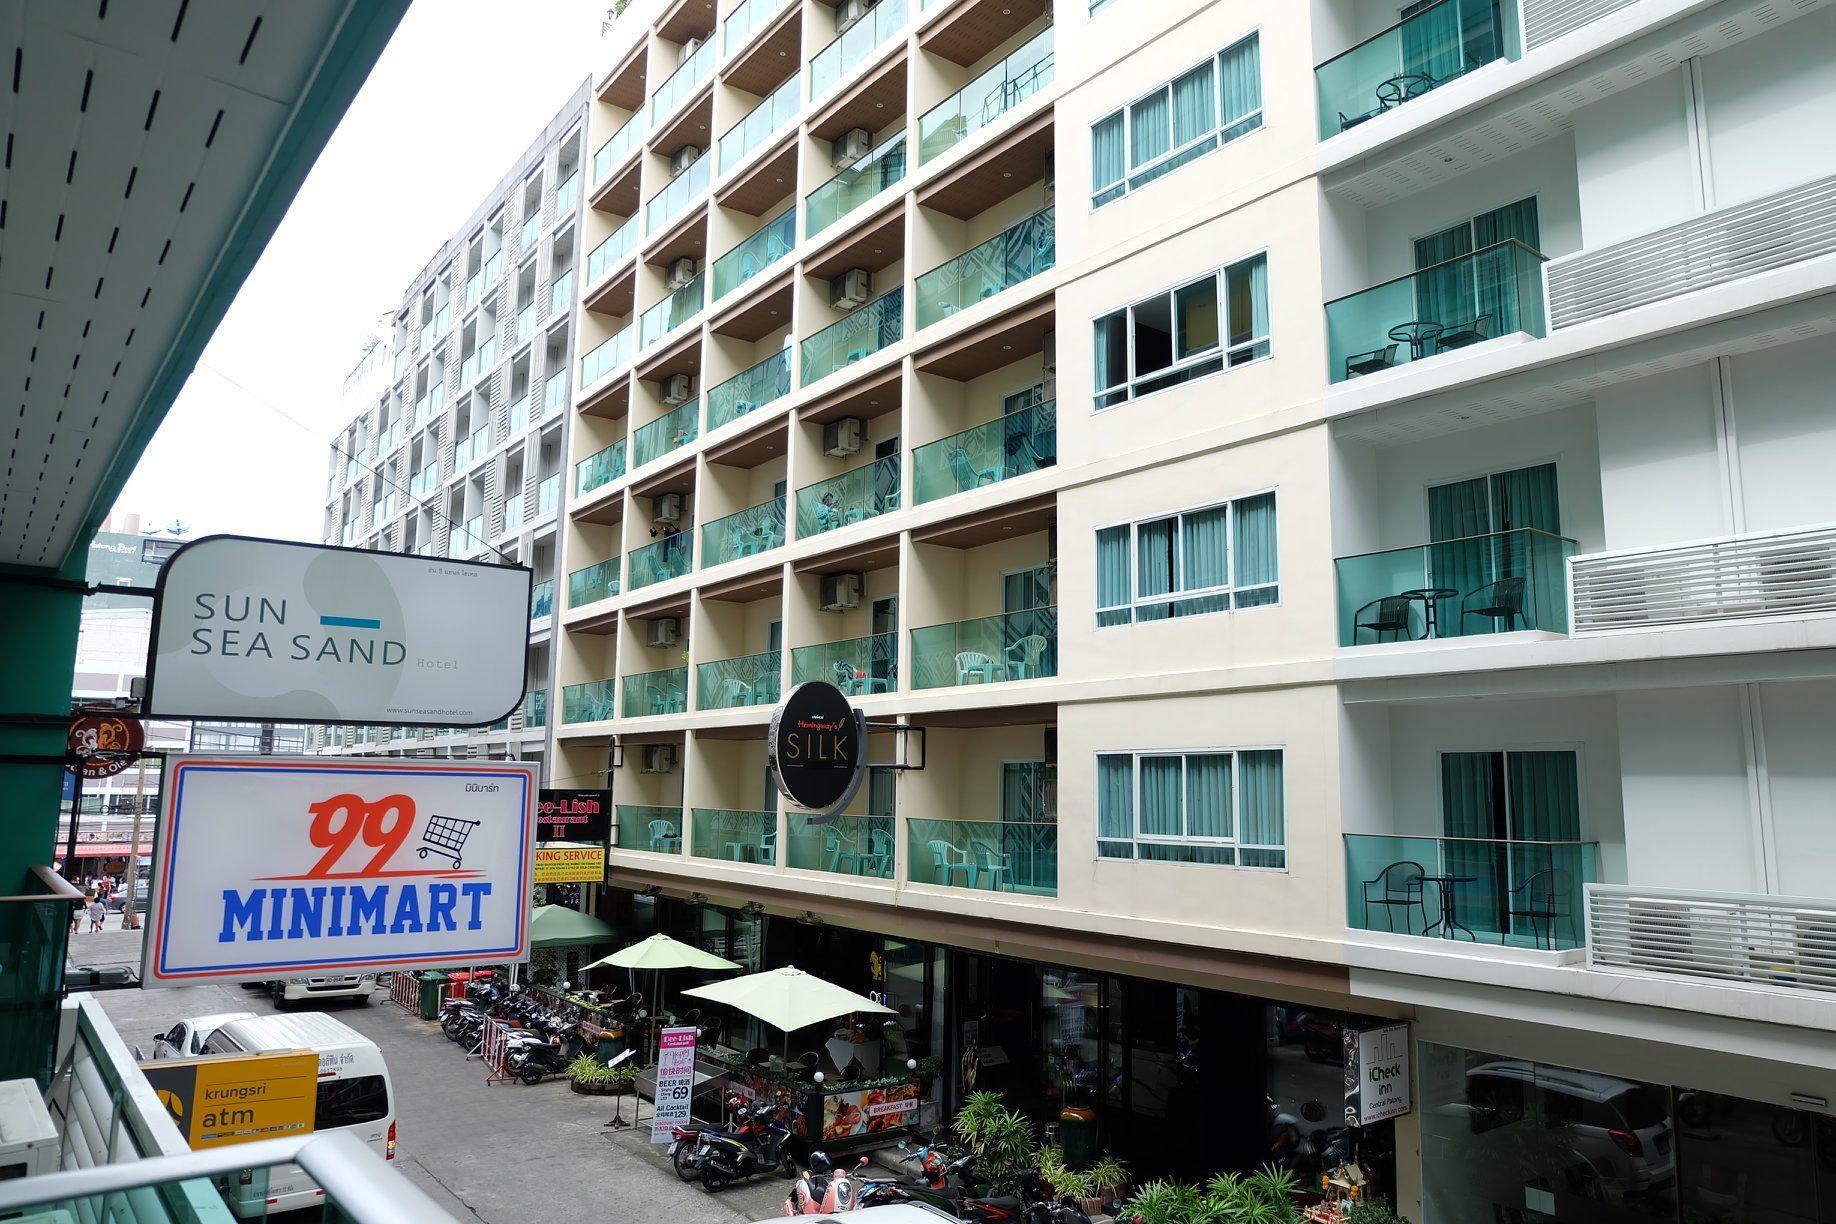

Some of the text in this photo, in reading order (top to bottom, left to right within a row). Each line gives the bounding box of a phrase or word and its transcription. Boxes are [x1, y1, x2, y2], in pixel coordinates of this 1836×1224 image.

[194, 593, 287, 625] SUN
[190, 628, 459, 670] SEA SAND Hotel
[386, 706, 473, 717] www.sunseasandhotel.com
[798, 719, 839, 732] Hemingway's
[786, 732, 848, 761] SILK
[538, 799, 600, 813] ee-Lish
[308, 793, 417, 876] 99
[536, 850, 602, 861] KING SERVICE
[218, 882, 492, 943] MINIMART
[1368, 1062, 1401, 1082] iCheck
[205, 1083, 267, 1101] krungsri
[658, 1080, 677, 1088] BEER
[1378, 1083, 1392, 1095] inn
[873, 1103, 903, 1114] BREAKFAST
[202, 1108, 254, 1128] atm
